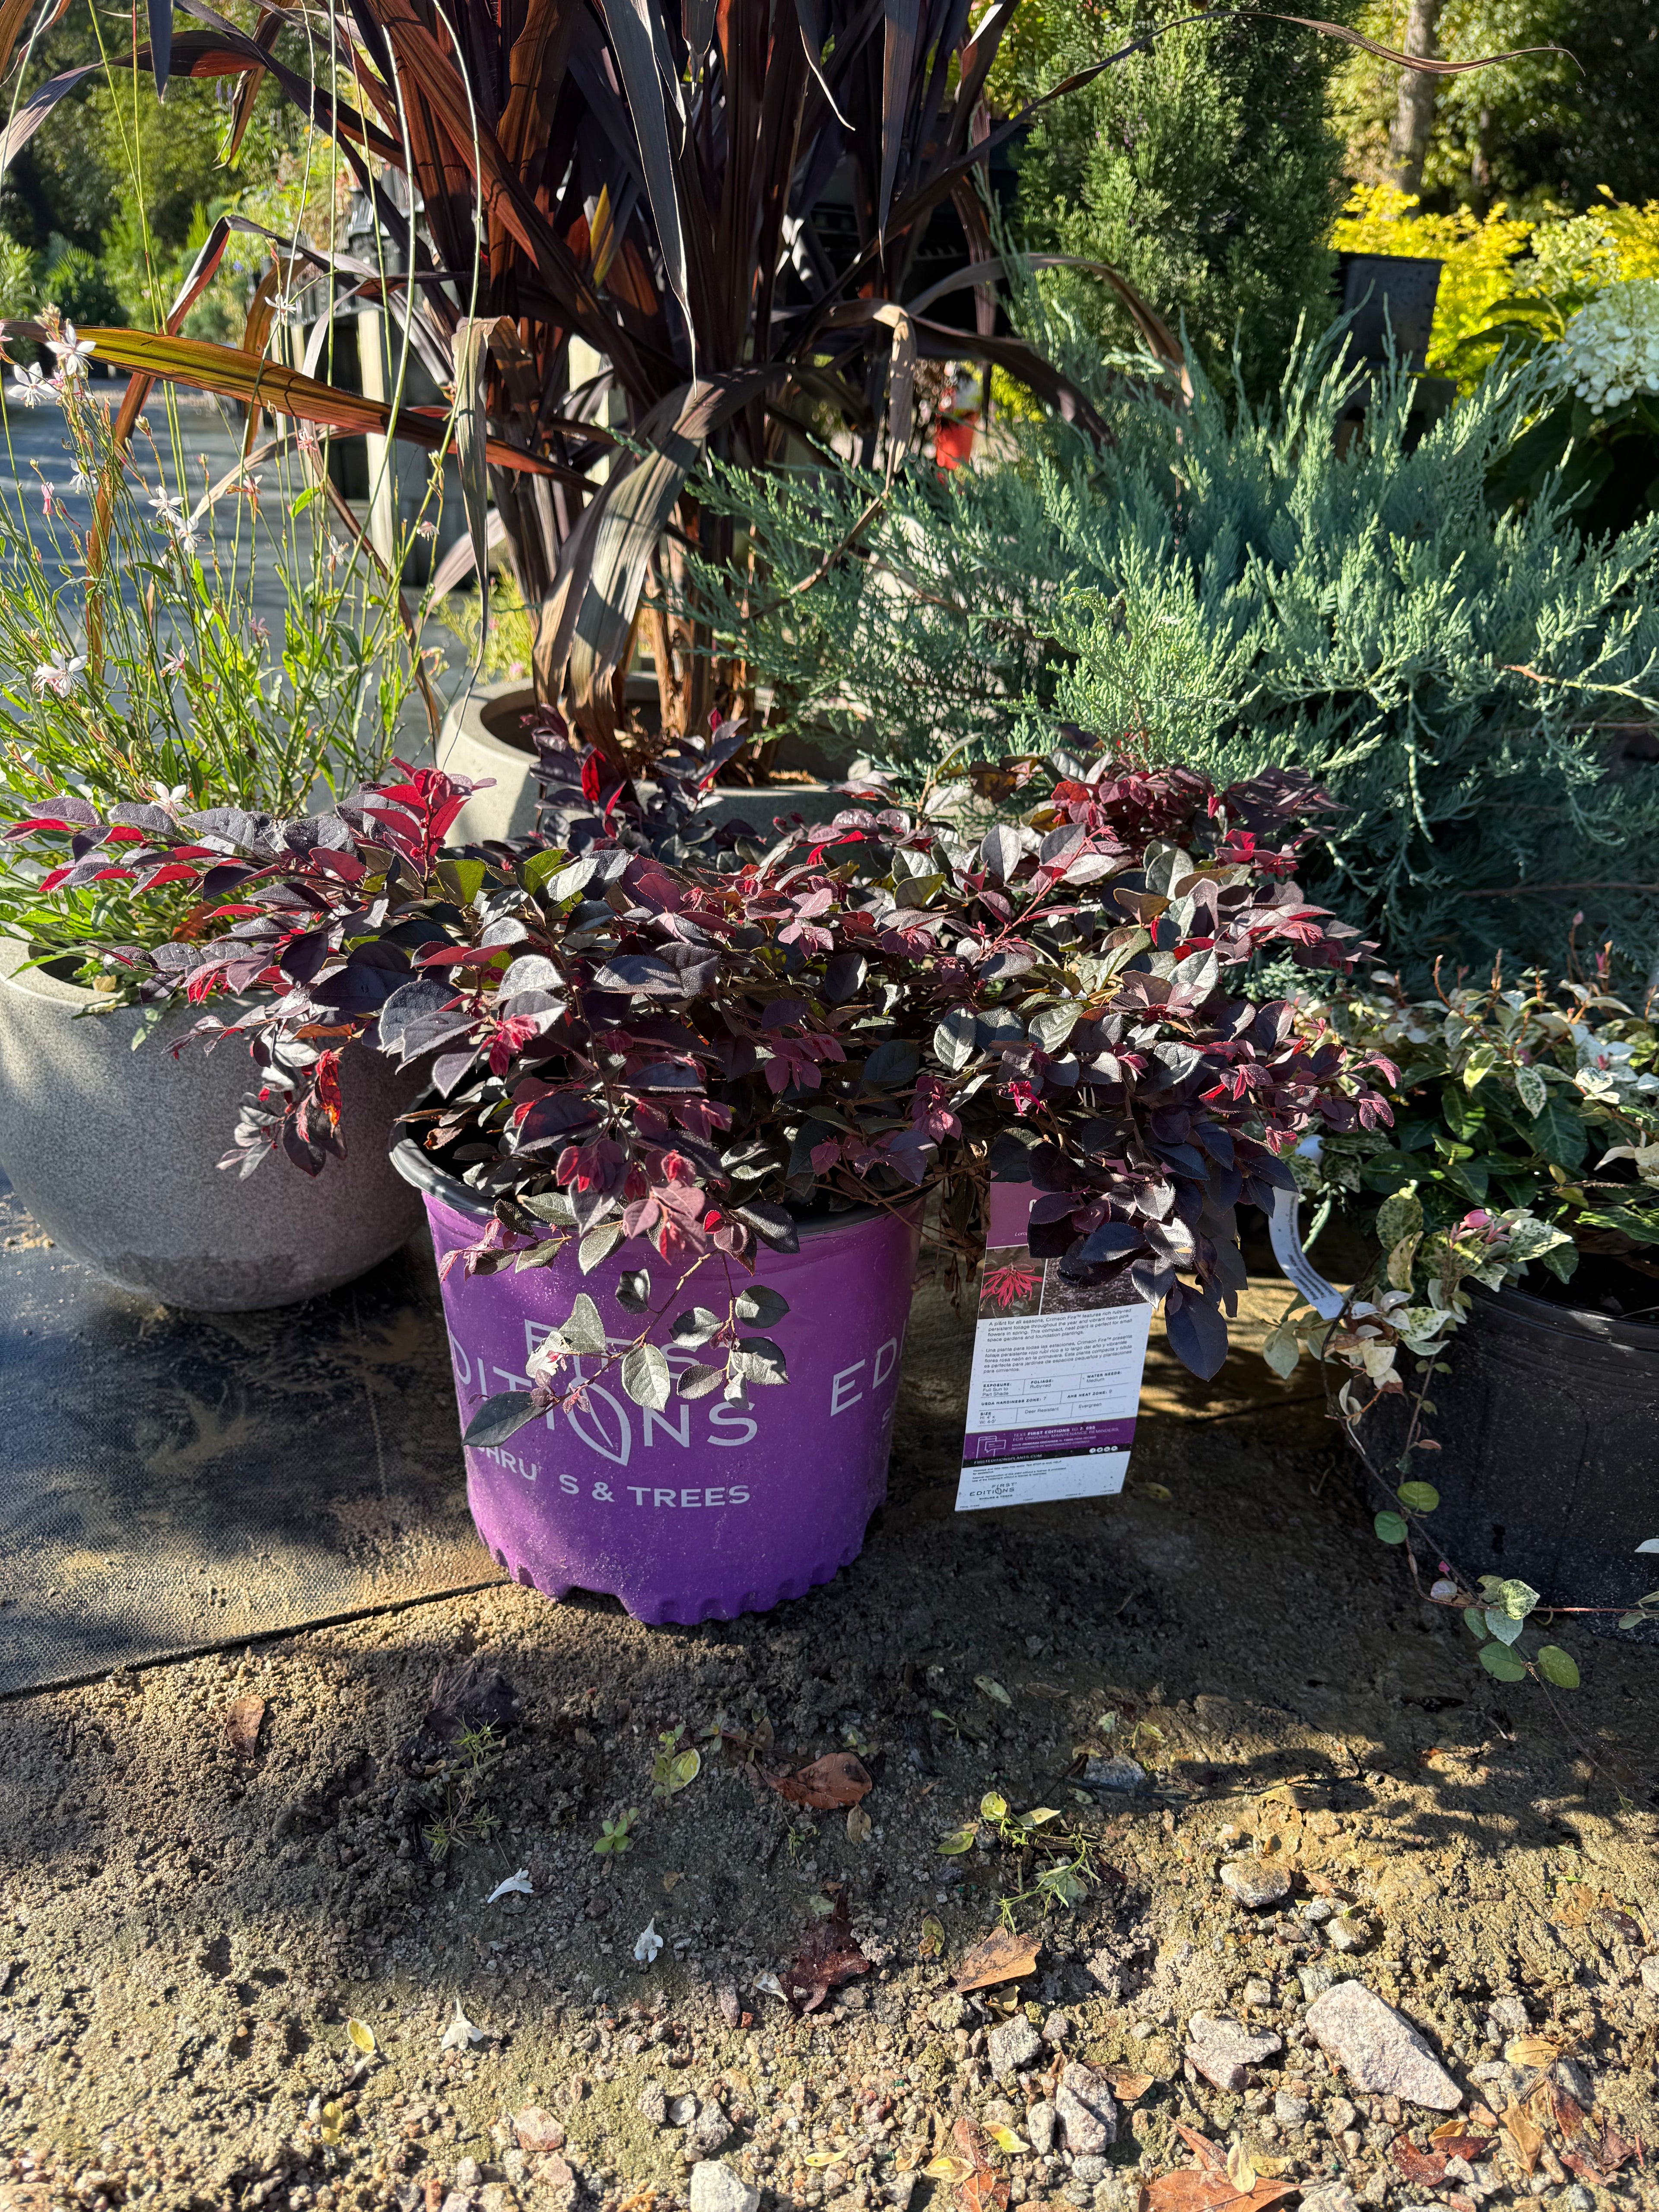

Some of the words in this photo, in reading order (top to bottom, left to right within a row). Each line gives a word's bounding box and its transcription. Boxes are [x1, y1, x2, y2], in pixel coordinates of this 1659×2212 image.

[591, 1481, 615, 1502] &
[627, 1485, 750, 1508] TREES
[969, 1486, 1015, 1497] EDITIONS
